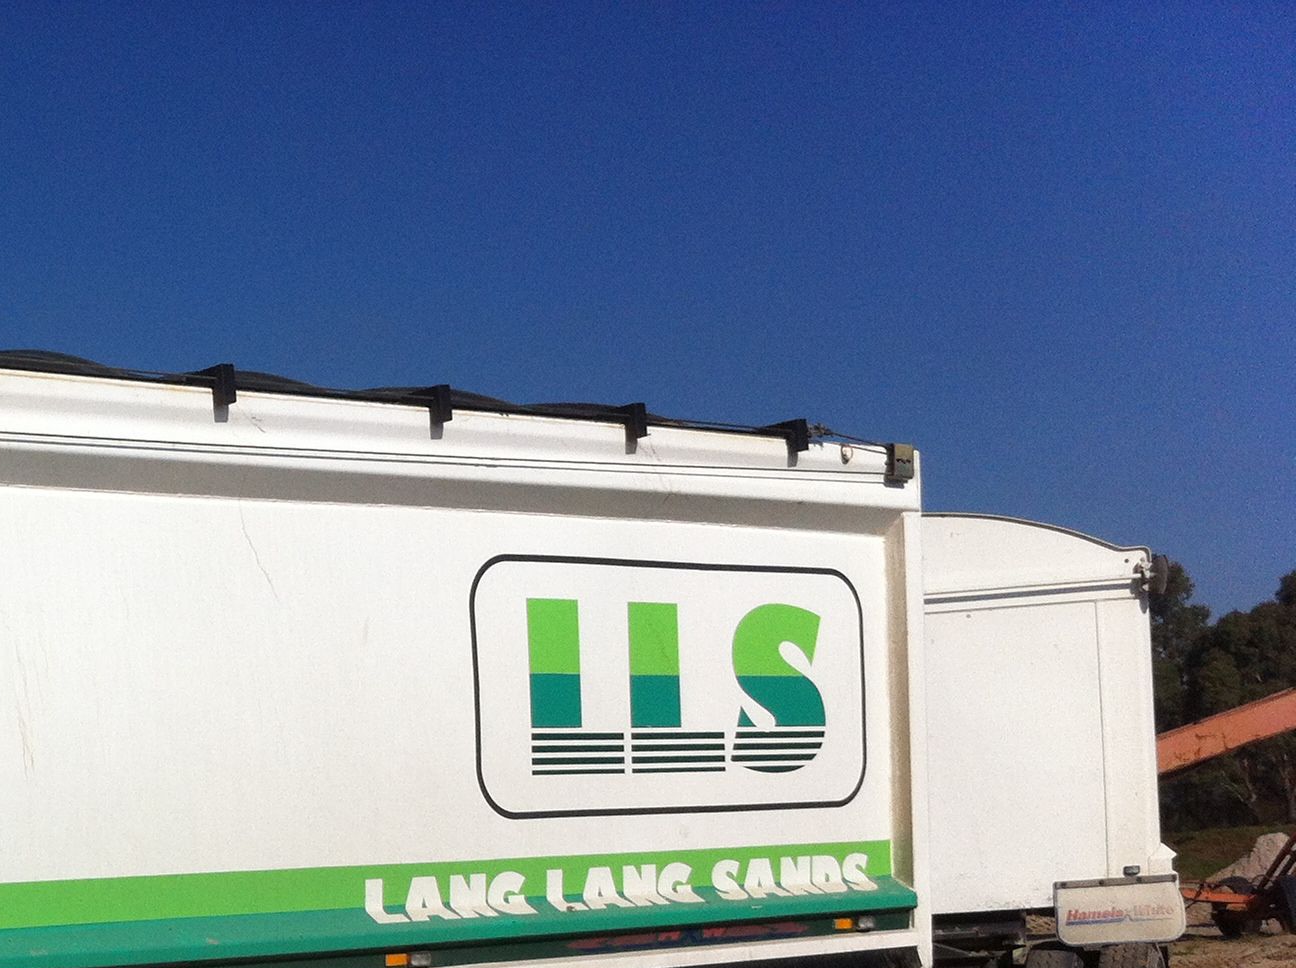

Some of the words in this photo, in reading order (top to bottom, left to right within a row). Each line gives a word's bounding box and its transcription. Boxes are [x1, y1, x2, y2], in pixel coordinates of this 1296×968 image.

[365, 871, 539, 924] LANG
[546, 861, 705, 912] LANG
[711, 853, 879, 900] SANDS
